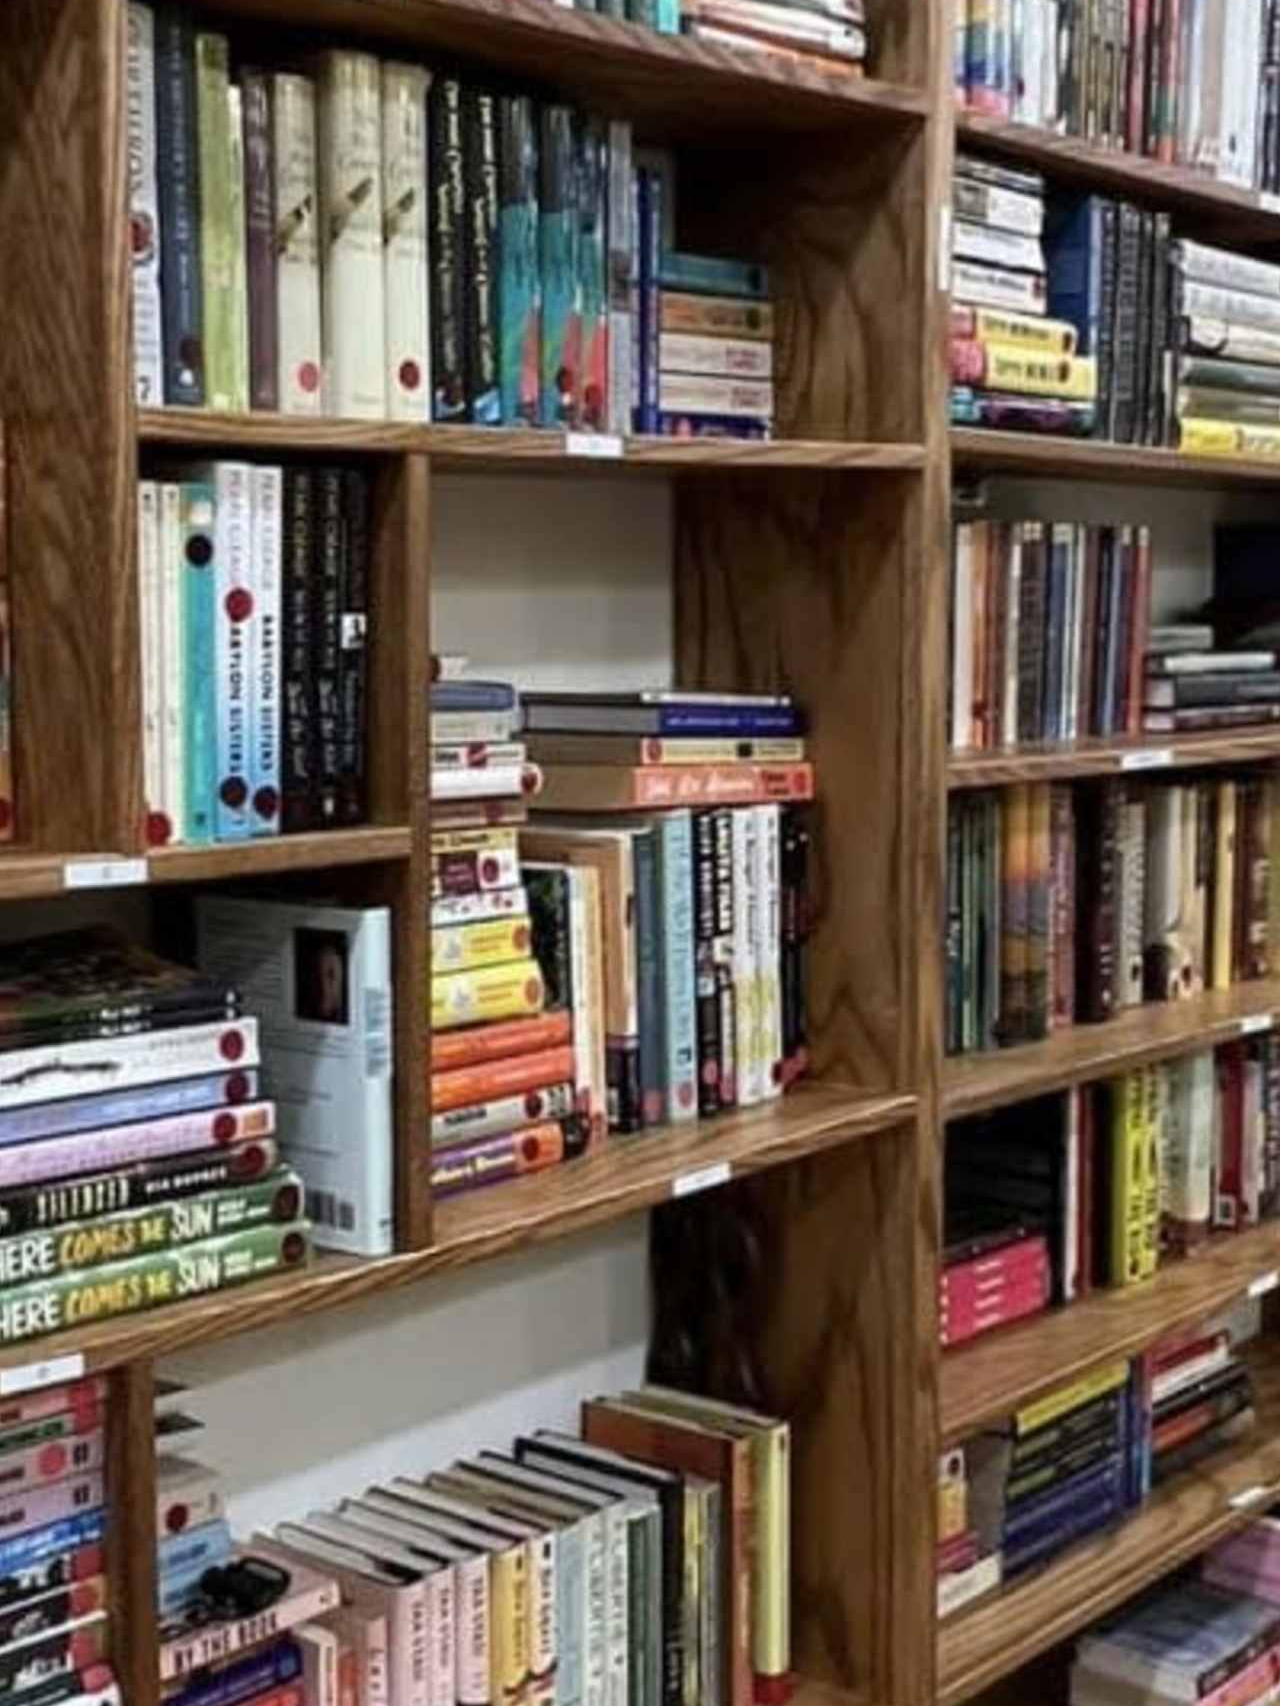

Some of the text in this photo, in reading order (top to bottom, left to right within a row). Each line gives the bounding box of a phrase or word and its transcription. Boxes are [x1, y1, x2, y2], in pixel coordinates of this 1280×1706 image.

[229, 623, 244, 701] ABYLON
[59, 1220, 136, 1264] COMES
[170, 1202, 214, 1240] SUN
[65, 1277, 142, 1321] COMES
[176, 1255, 220, 1294] SUN
